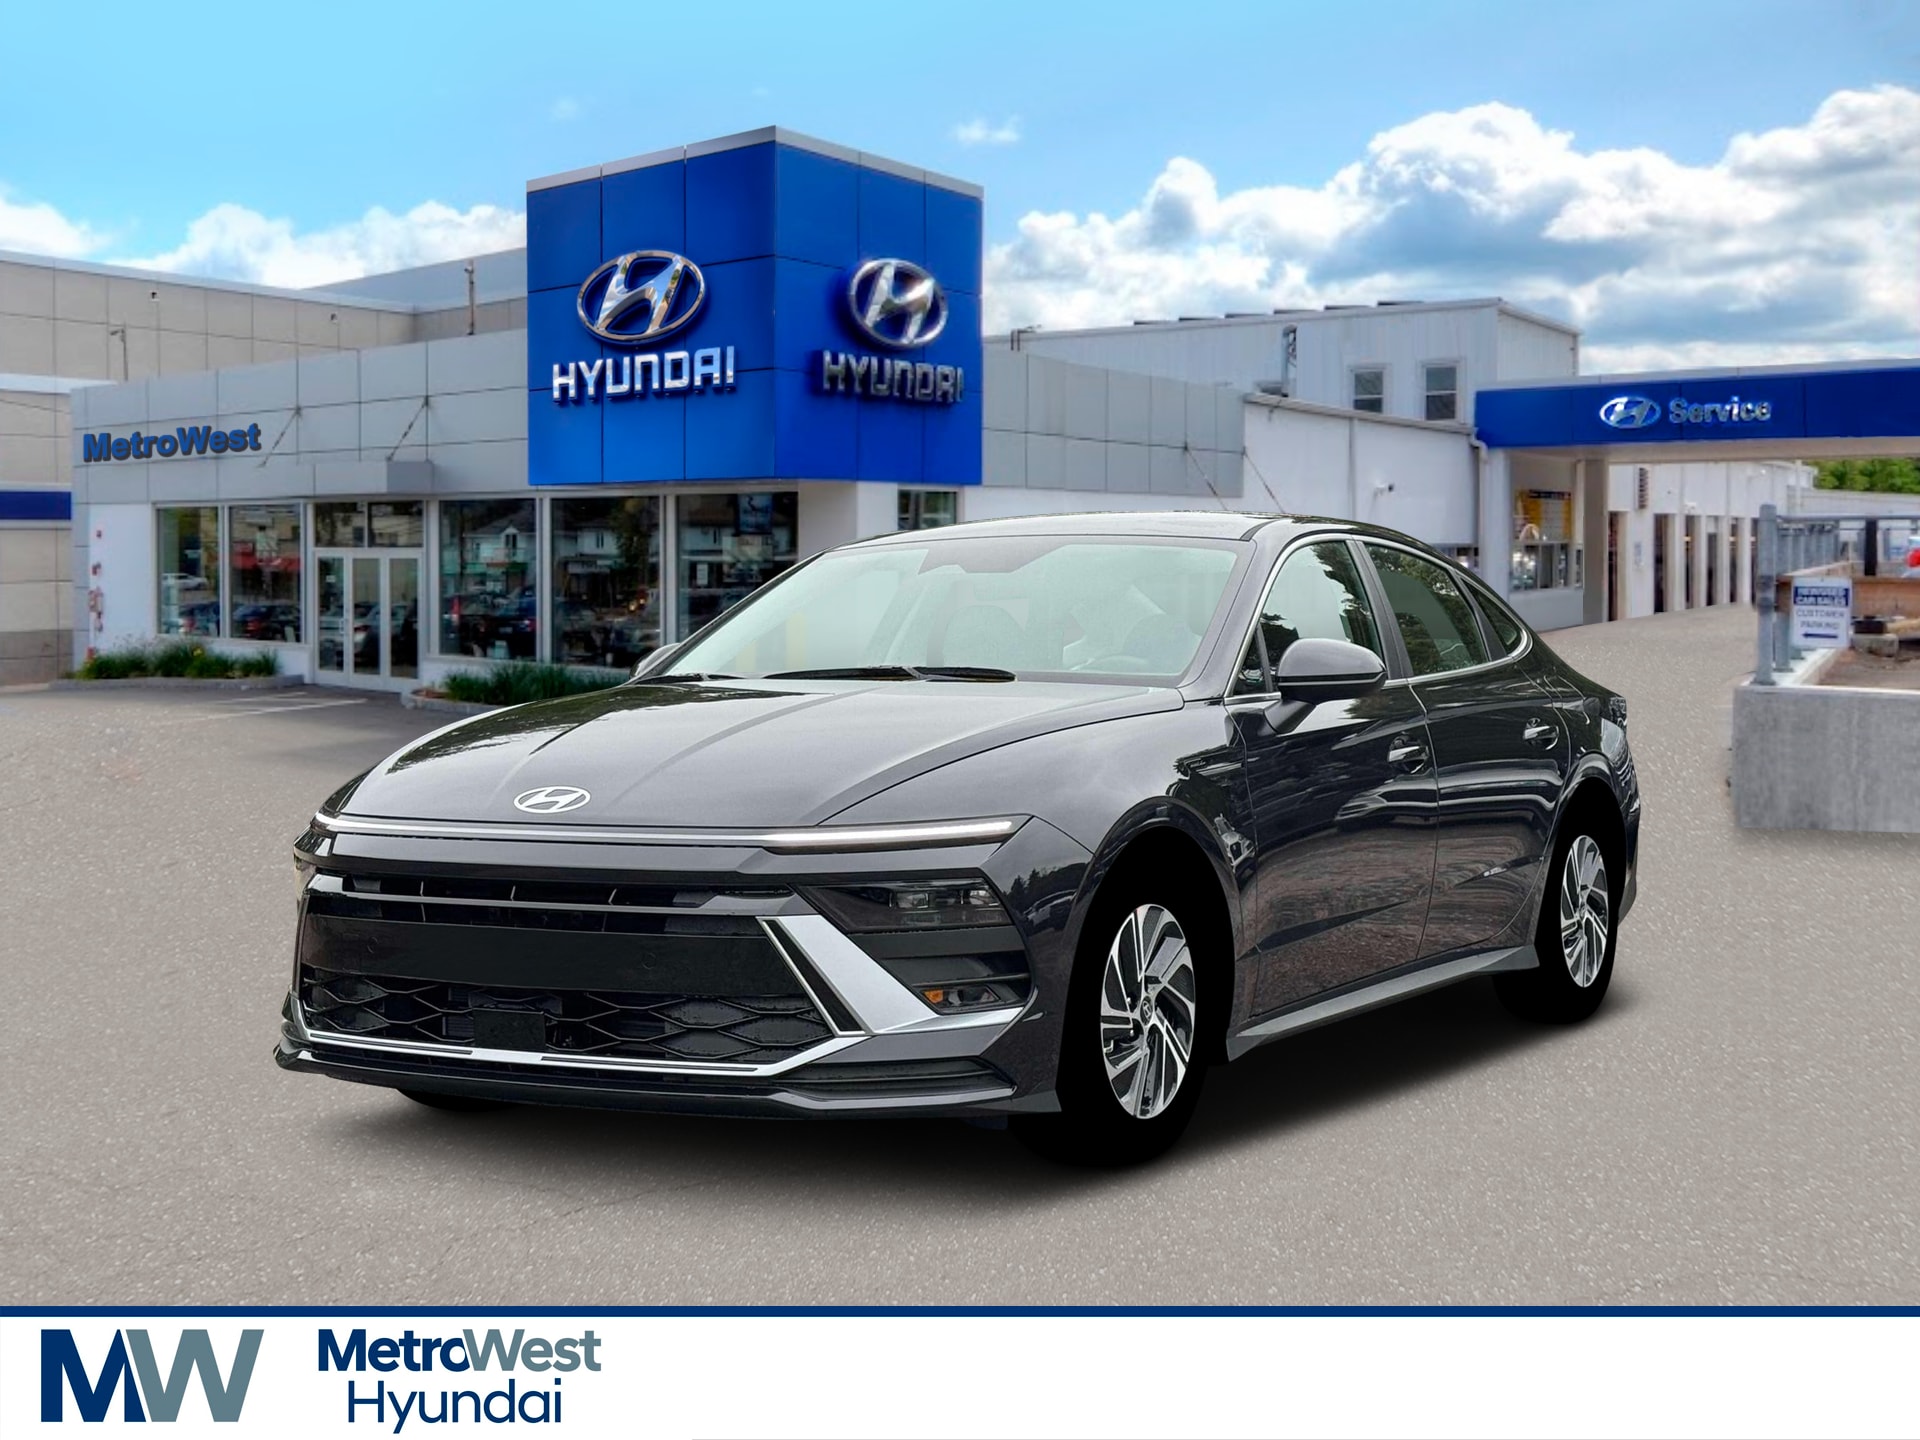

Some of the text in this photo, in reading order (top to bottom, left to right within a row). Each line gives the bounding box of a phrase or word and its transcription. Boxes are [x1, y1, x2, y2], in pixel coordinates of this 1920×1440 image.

[552, 345, 736, 402] HYUNDAI
[822, 349, 964, 403] HYUNDAI
[1669, 396, 1771, 424] Service
[83, 422, 261, 462] MetroWest
